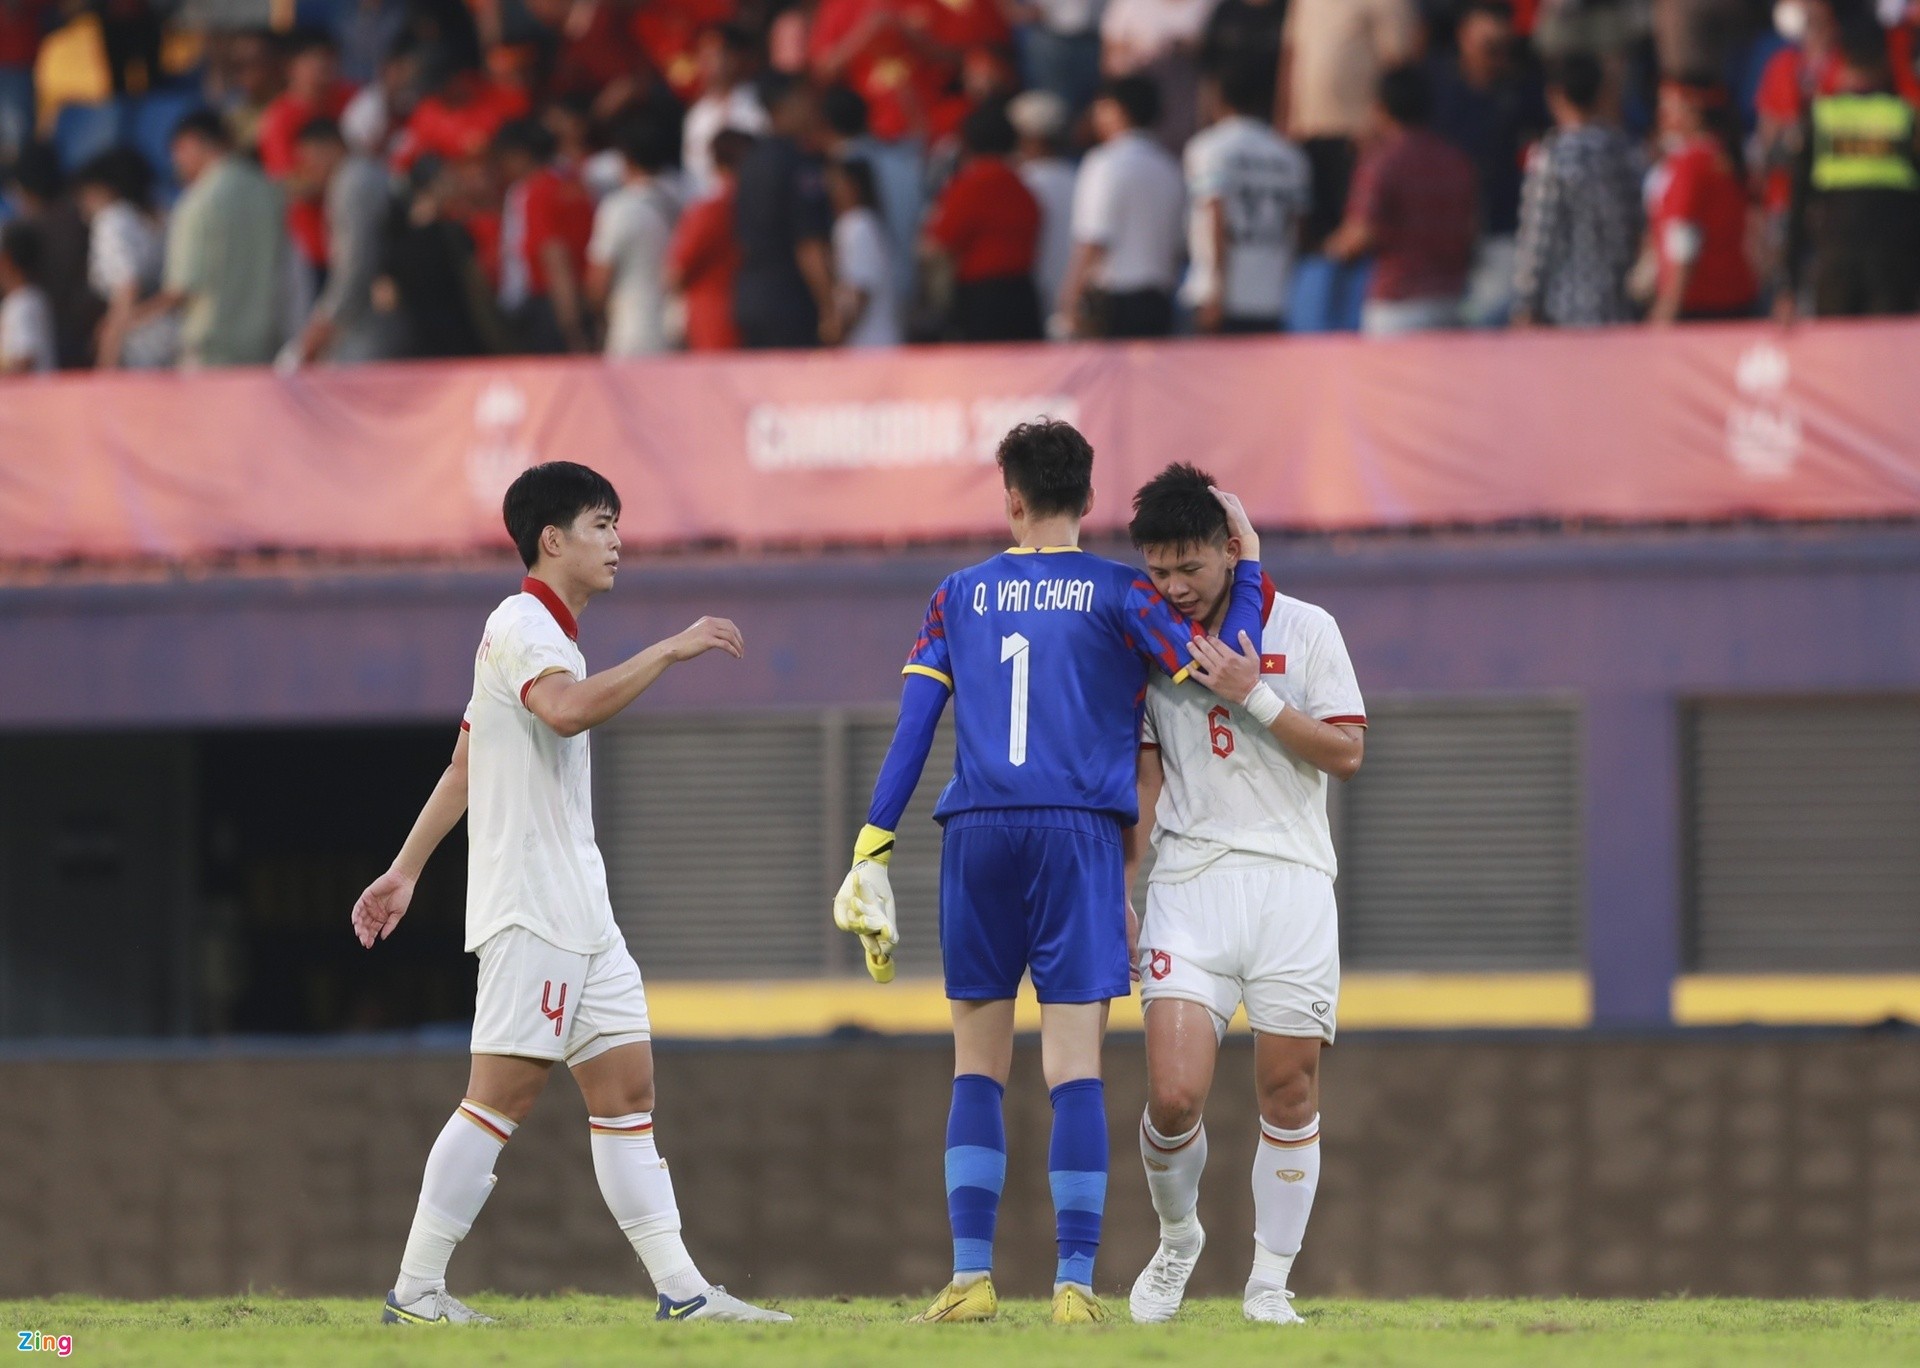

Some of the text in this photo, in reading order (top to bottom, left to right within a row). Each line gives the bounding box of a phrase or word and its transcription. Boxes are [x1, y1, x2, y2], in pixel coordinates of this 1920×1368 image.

[972, 578, 1095, 617] Q. VAN CHUAN
[1000, 631, 1030, 767] 1
[1207, 704, 1235, 759] 6
[1149, 949, 1172, 981] 6
[542, 980, 567, 1037] 4
